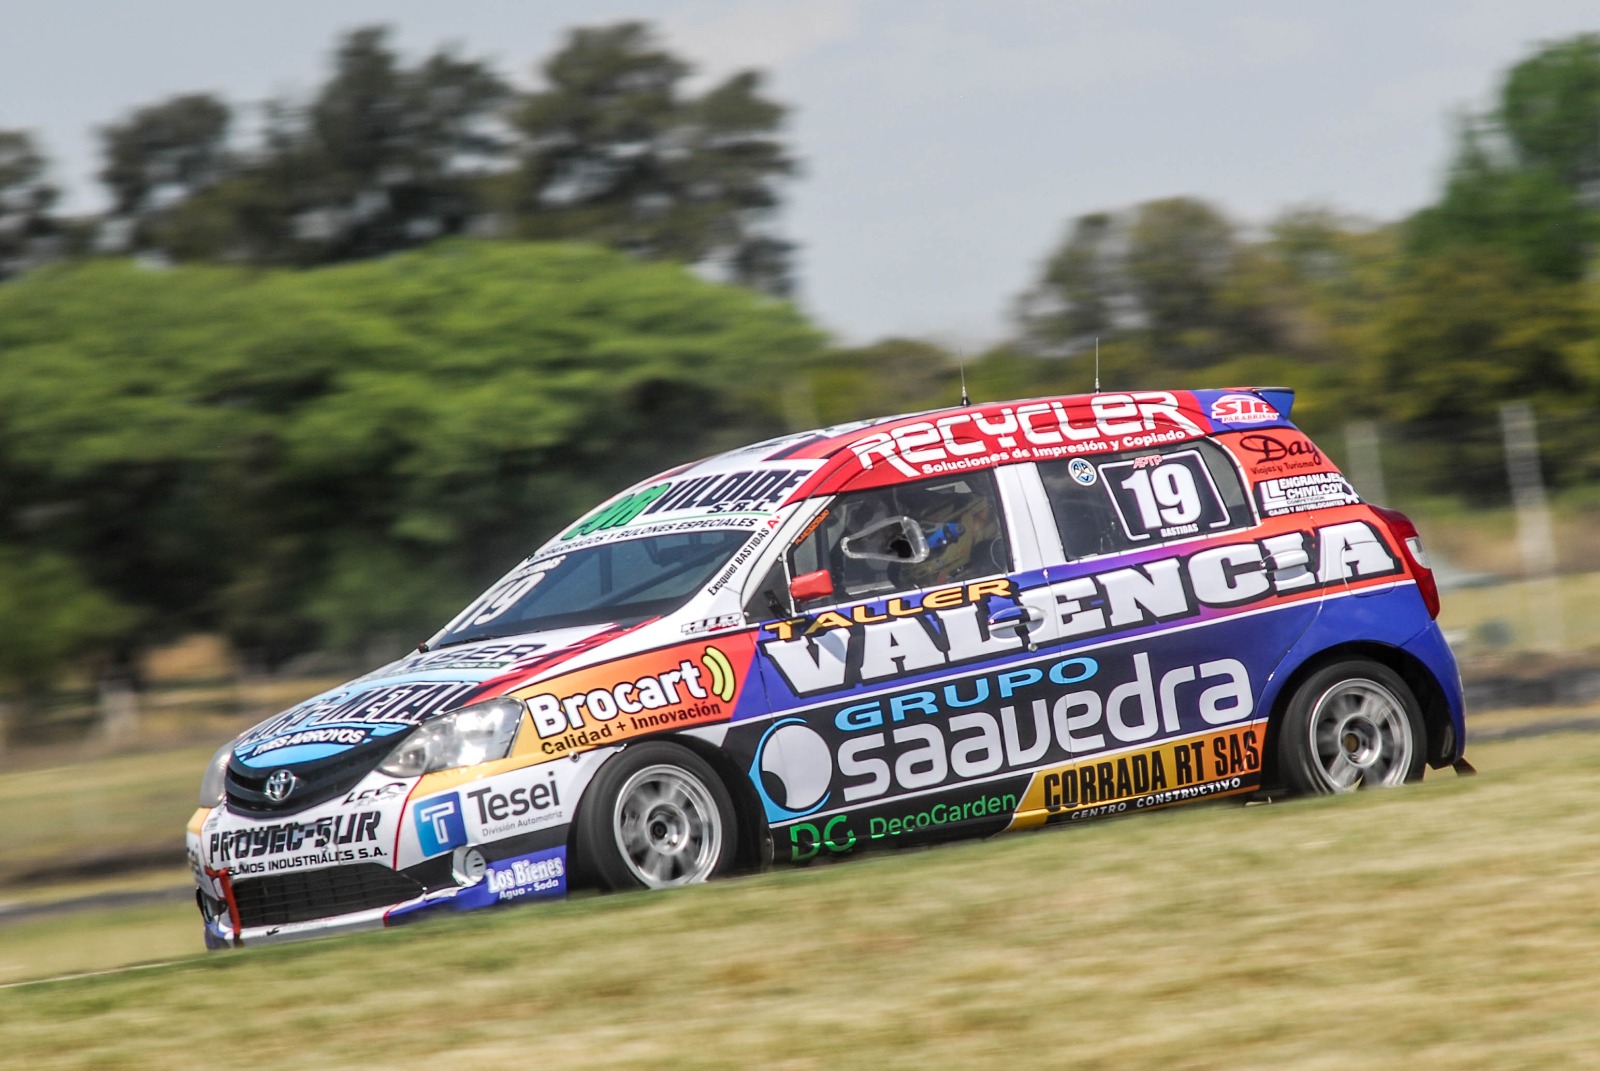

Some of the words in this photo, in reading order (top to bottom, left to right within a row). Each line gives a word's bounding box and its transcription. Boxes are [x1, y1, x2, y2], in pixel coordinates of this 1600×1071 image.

[921, 452, 1009, 475] Soluciones
[1012, 448, 1031, 460] de
[1033, 440, 1109, 459] Impresión
[1111, 439, 1121, 451] y
[1122, 429, 1187, 447] Copiado
[1239, 434, 1322, 466] Day
[1120, 463, 1202, 529] 19
[1279, 472, 1341, 489] ENGRANAJES
[1286, 482, 1343, 499] CHIVILCOY
[617, 523, 677, 539] BULONES
[676, 517, 758, 531] ESPECIALES
[1161, 523, 1199, 538] BASTIDAS
[707, 564, 738, 596] Exequiel
[735, 527, 770, 566] BASTIDAS
[763, 521, 1396, 694] VALENCIA
[765, 579, 1011, 639] TALLER
[526, 659, 708, 739] Brocart
[834, 657, 1099, 732] GRUPO
[288, 728, 366, 744] ARROYOS
[541, 724, 613, 755] Calidad
[616, 721, 627, 733] +
[630, 702, 721, 731] Innovación
[1044, 751, 1167, 813] CORRADA
[1174, 740, 1205, 785] RT
[1212, 730, 1260, 777] SAS
[467, 771, 560, 825] Tesei
[870, 793, 1017, 839] DecoGarden
[1071, 802, 1127, 820] CENTRO
[1136, 777, 1241, 809] CONSTRUCTIVO
[209, 810, 382, 864] PROYEC-SUR
[482, 823, 515, 837] División
[517, 811, 563, 828] Automotriz
[268, 849, 354, 870] INDUSTRIALES
[359, 846, 388, 859] S.A.
[486, 868, 514, 893] Los
[512, 857, 564, 887] Bienes
[499, 888, 525, 900] Agua
[534, 878, 559, 892] Soda
